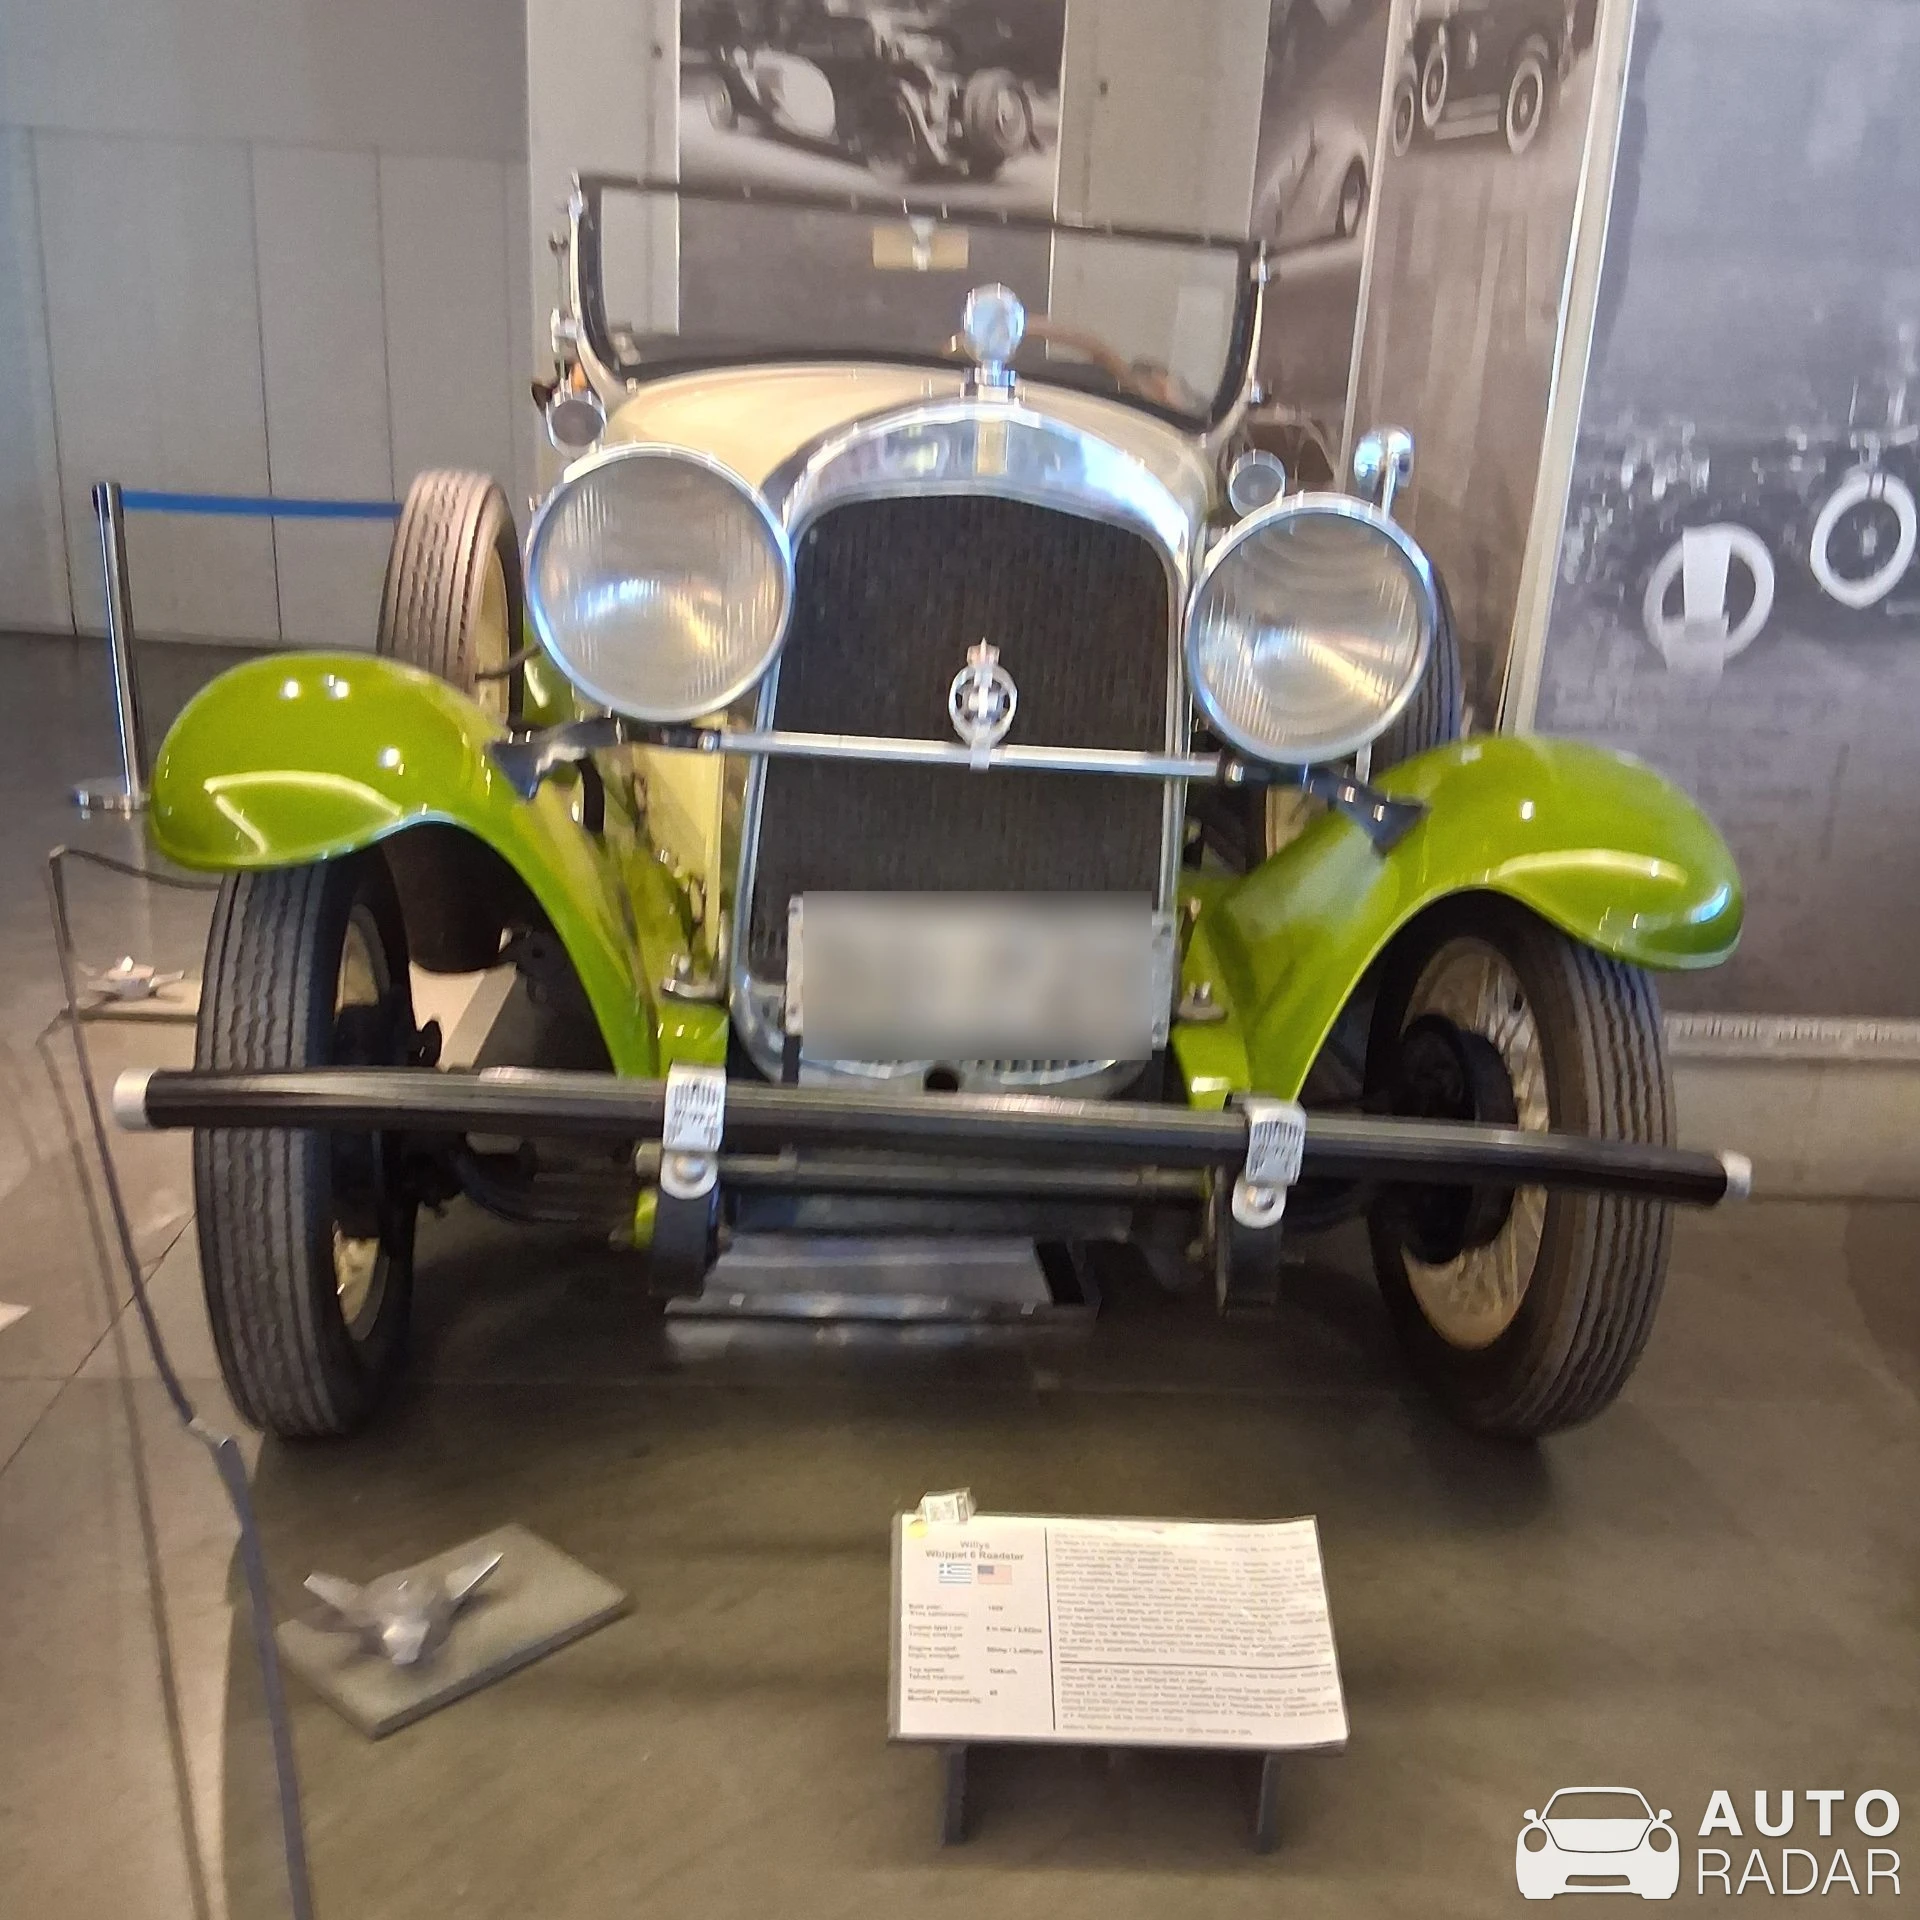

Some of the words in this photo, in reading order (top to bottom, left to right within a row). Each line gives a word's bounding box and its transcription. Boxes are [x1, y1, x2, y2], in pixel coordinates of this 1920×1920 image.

[960, 1540, 990, 1552] Willys
[925, 1550, 967, 1560] Whippet
[970, 1551, 976, 1559] 6
[979, 1551, 1024, 1560] Roadster
